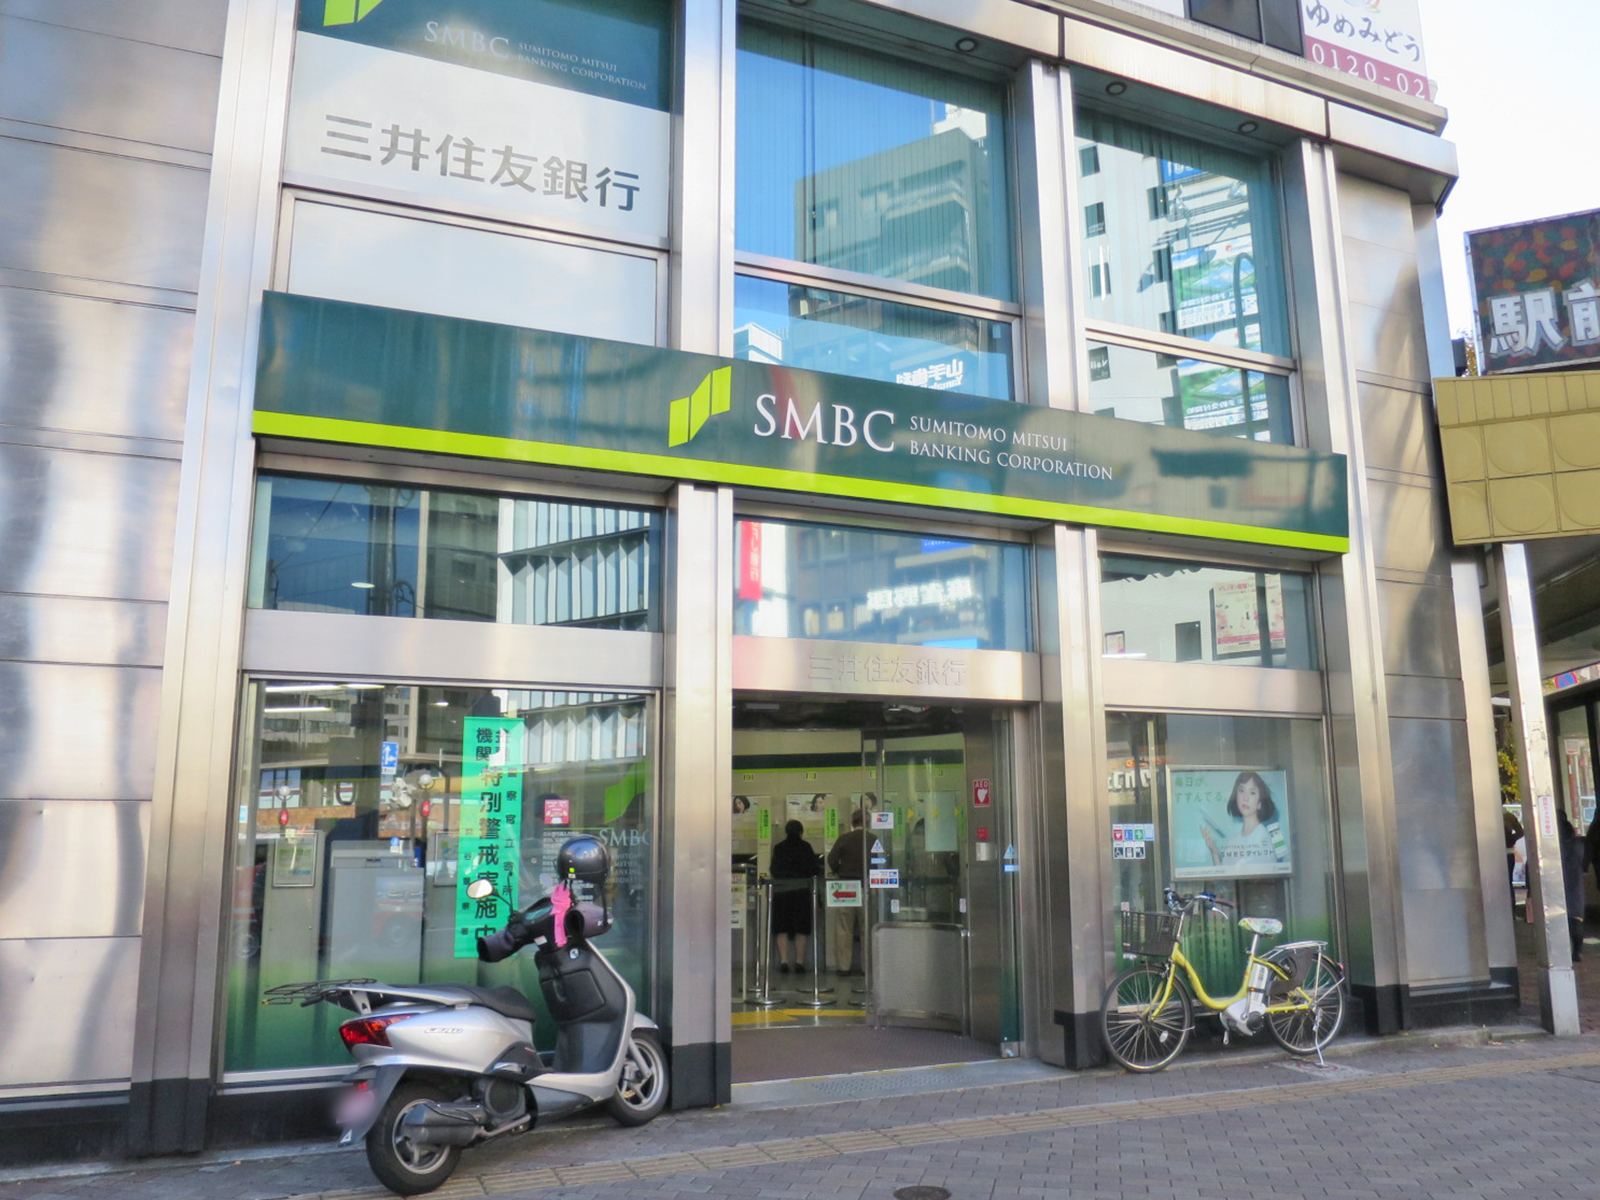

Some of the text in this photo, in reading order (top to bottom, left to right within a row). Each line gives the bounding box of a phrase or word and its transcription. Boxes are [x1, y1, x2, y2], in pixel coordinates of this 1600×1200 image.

[424, 21, 509, 59] SMBC
[1306, 0, 1420, 62] ゆめみどう
[518, 42, 618, 72] SUMITOMO MITSUI
[518, 54, 647, 91] BANKING CORPORATION
[1312, 43, 1425, 99] 0120-02
[320, 114, 640, 211] 三井住友銀行
[754, 394, 895, 453] SMBC
[909, 416, 1067, 451] SUMITOMO MITSUI
[910, 441, 1114, 481] BANKING CORPORATION
[808, 655, 966, 686] 三井住友銀行
[975, 780, 988, 788] AED
